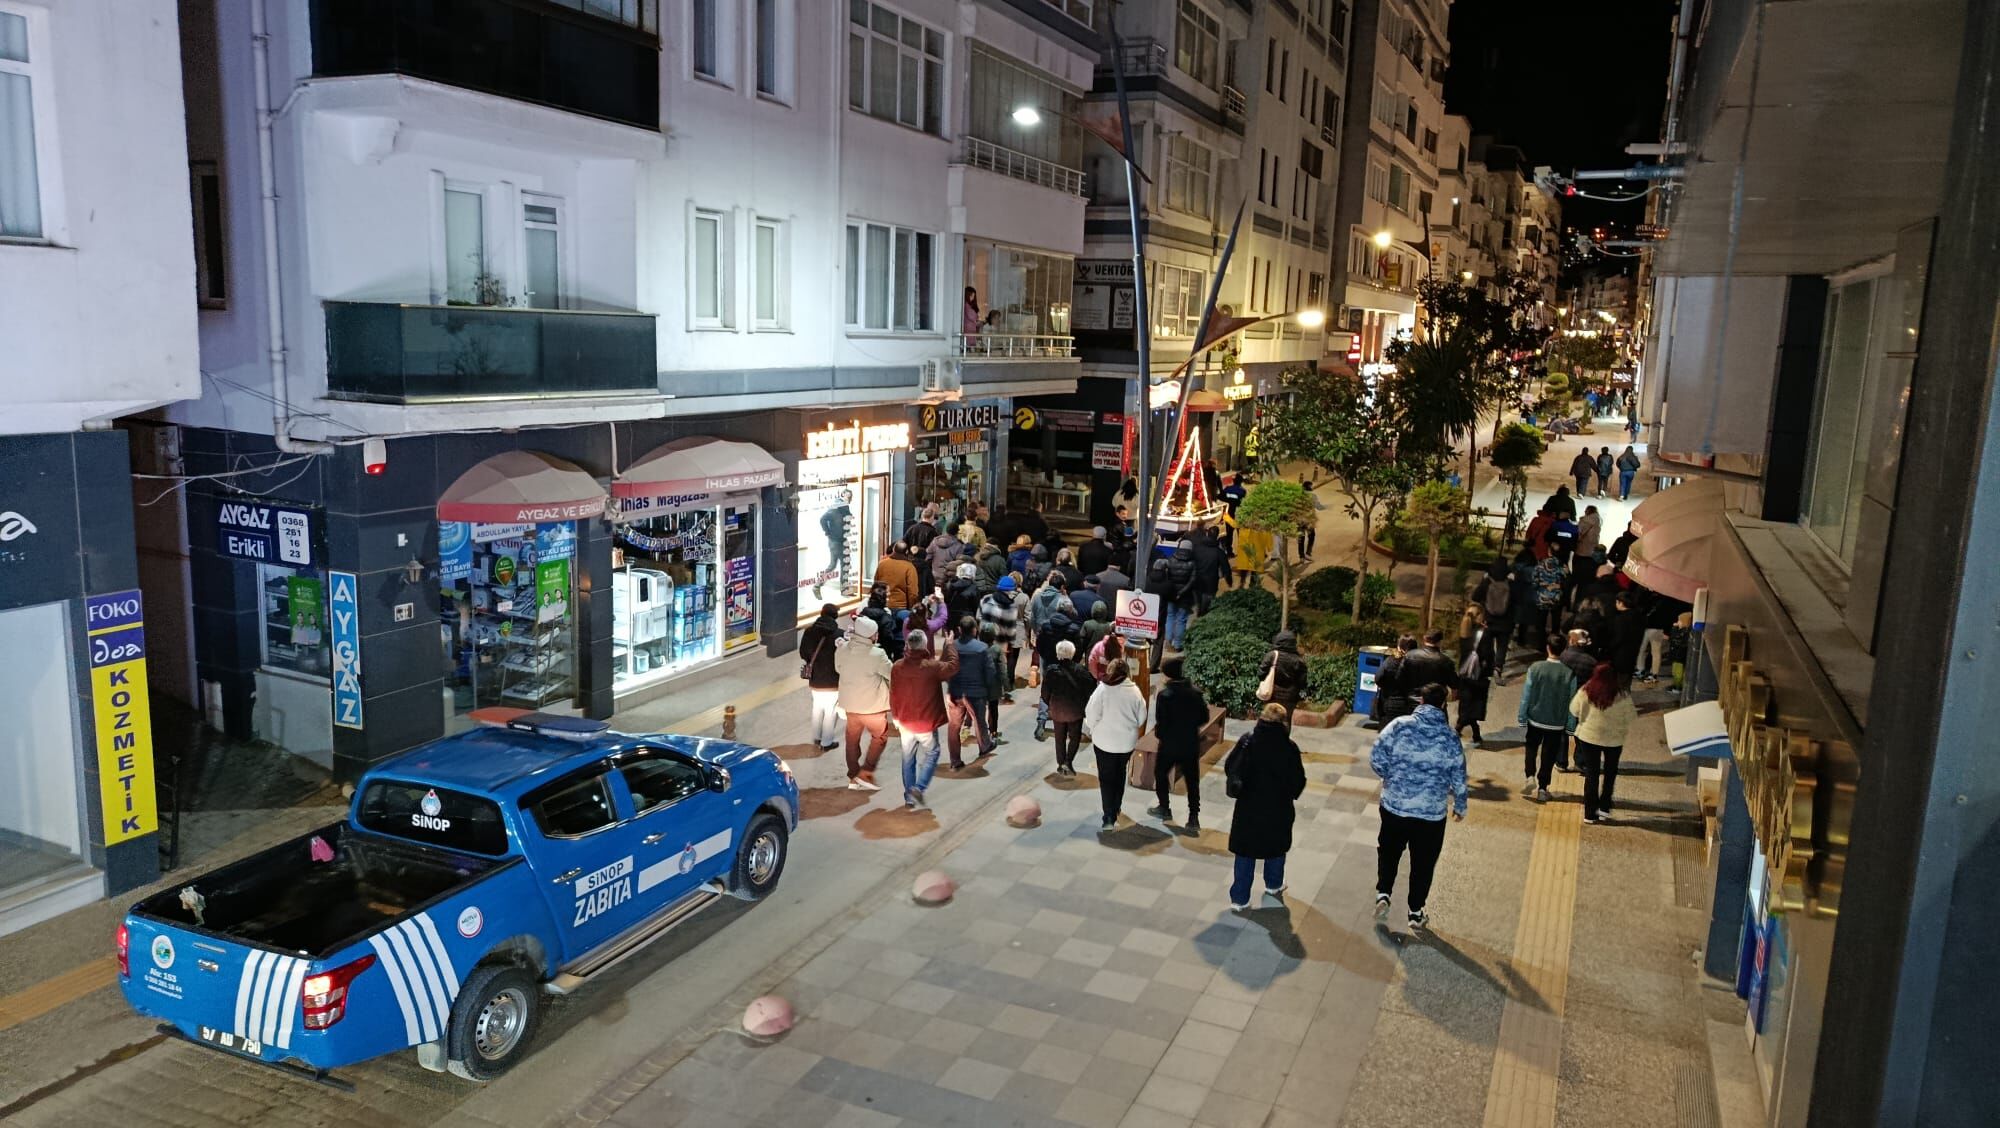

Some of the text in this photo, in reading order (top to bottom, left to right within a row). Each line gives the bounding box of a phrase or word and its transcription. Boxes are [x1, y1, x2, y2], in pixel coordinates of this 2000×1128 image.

[218, 503, 271, 529] AYGAZ
[281, 516, 304, 527] 0368
[517, 508, 559, 520] AYGAZ
[562, 506, 576, 517] VE
[228, 535, 265, 558] Erikli
[289, 539, 300, 547] 16
[289, 549, 301, 558] 23
[89, 599, 139, 622] FOKO
[573, 876, 632, 928] ZABITA
